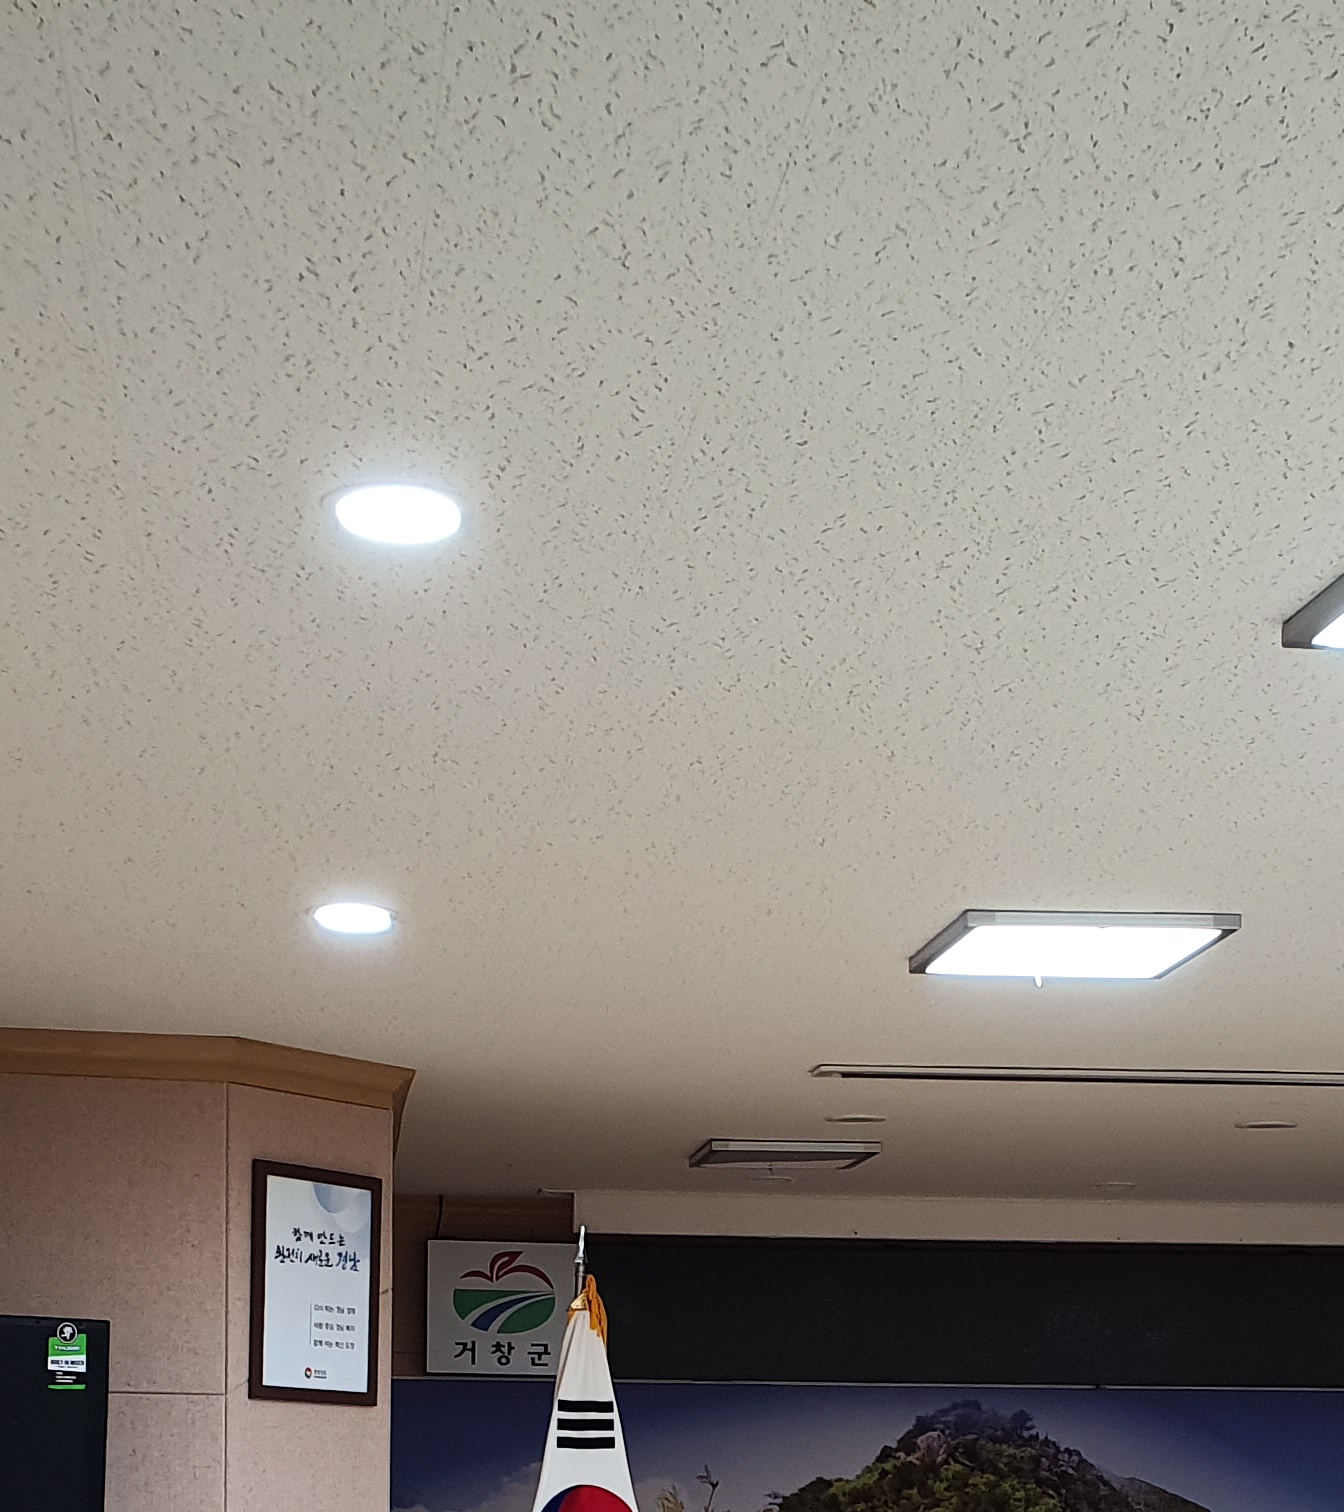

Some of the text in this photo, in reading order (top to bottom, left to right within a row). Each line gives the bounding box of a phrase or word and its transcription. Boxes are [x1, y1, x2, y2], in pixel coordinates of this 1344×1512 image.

[292, 1227, 346, 1246] 함께 만드는
[274, 1244, 360, 1271] 완전히 새로운 경남
[454, 1340, 552, 1367] 거창군
